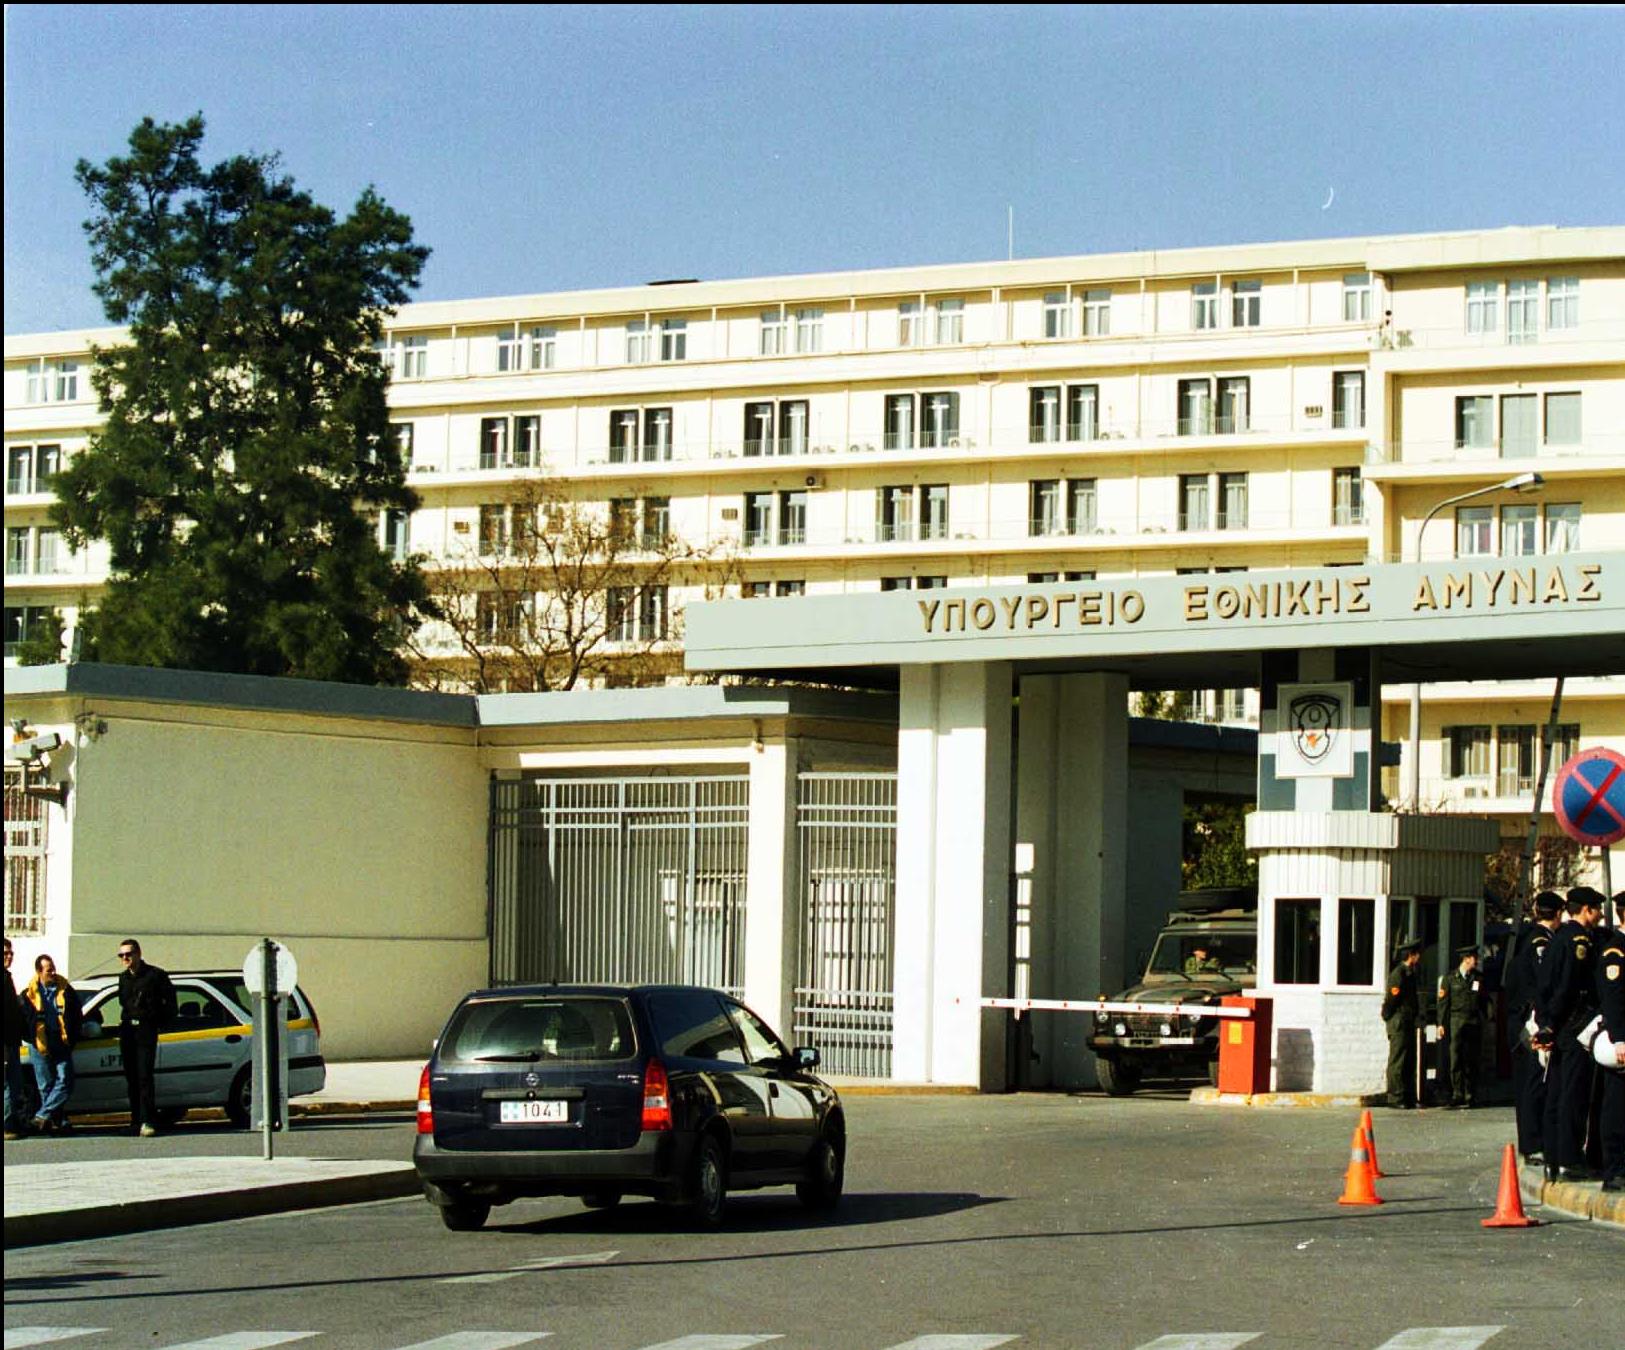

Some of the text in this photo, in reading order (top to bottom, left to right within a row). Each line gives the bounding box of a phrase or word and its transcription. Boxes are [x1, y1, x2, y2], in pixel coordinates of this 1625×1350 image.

[917, 564, 1602, 633] ΥΠΟΥΡΓΕΙΟ ΕΘΝΙΚΗΣ ΑΜΥΝΑΣ
[523, 1102, 562, 1118] 1041
